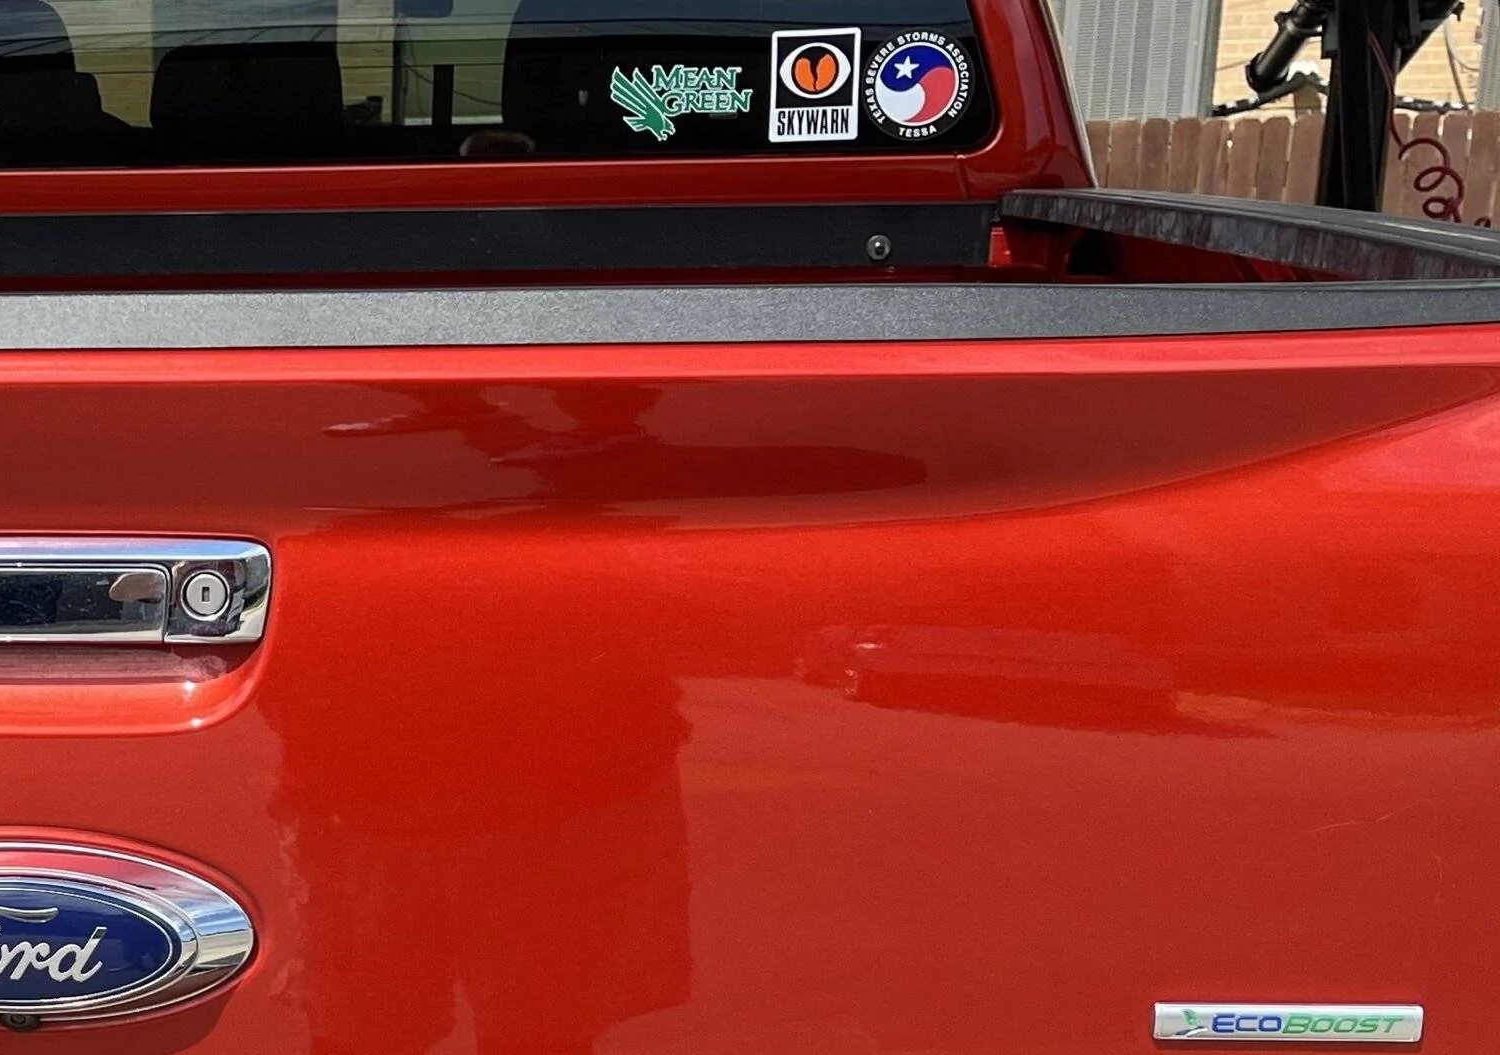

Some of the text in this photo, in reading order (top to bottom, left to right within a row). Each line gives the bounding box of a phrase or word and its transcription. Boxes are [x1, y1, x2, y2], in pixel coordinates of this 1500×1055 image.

[651, 64, 742, 91] MEAN
[865, 31, 970, 124] TEXAS SEVERE STORMS ASSOCIATION
[661, 89, 753, 117] GREEN
[777, 108, 849, 136] SKYWARN
[898, 125, 937, 138] TESSA
[1211, 1012, 1404, 1035] ECOBOOST
